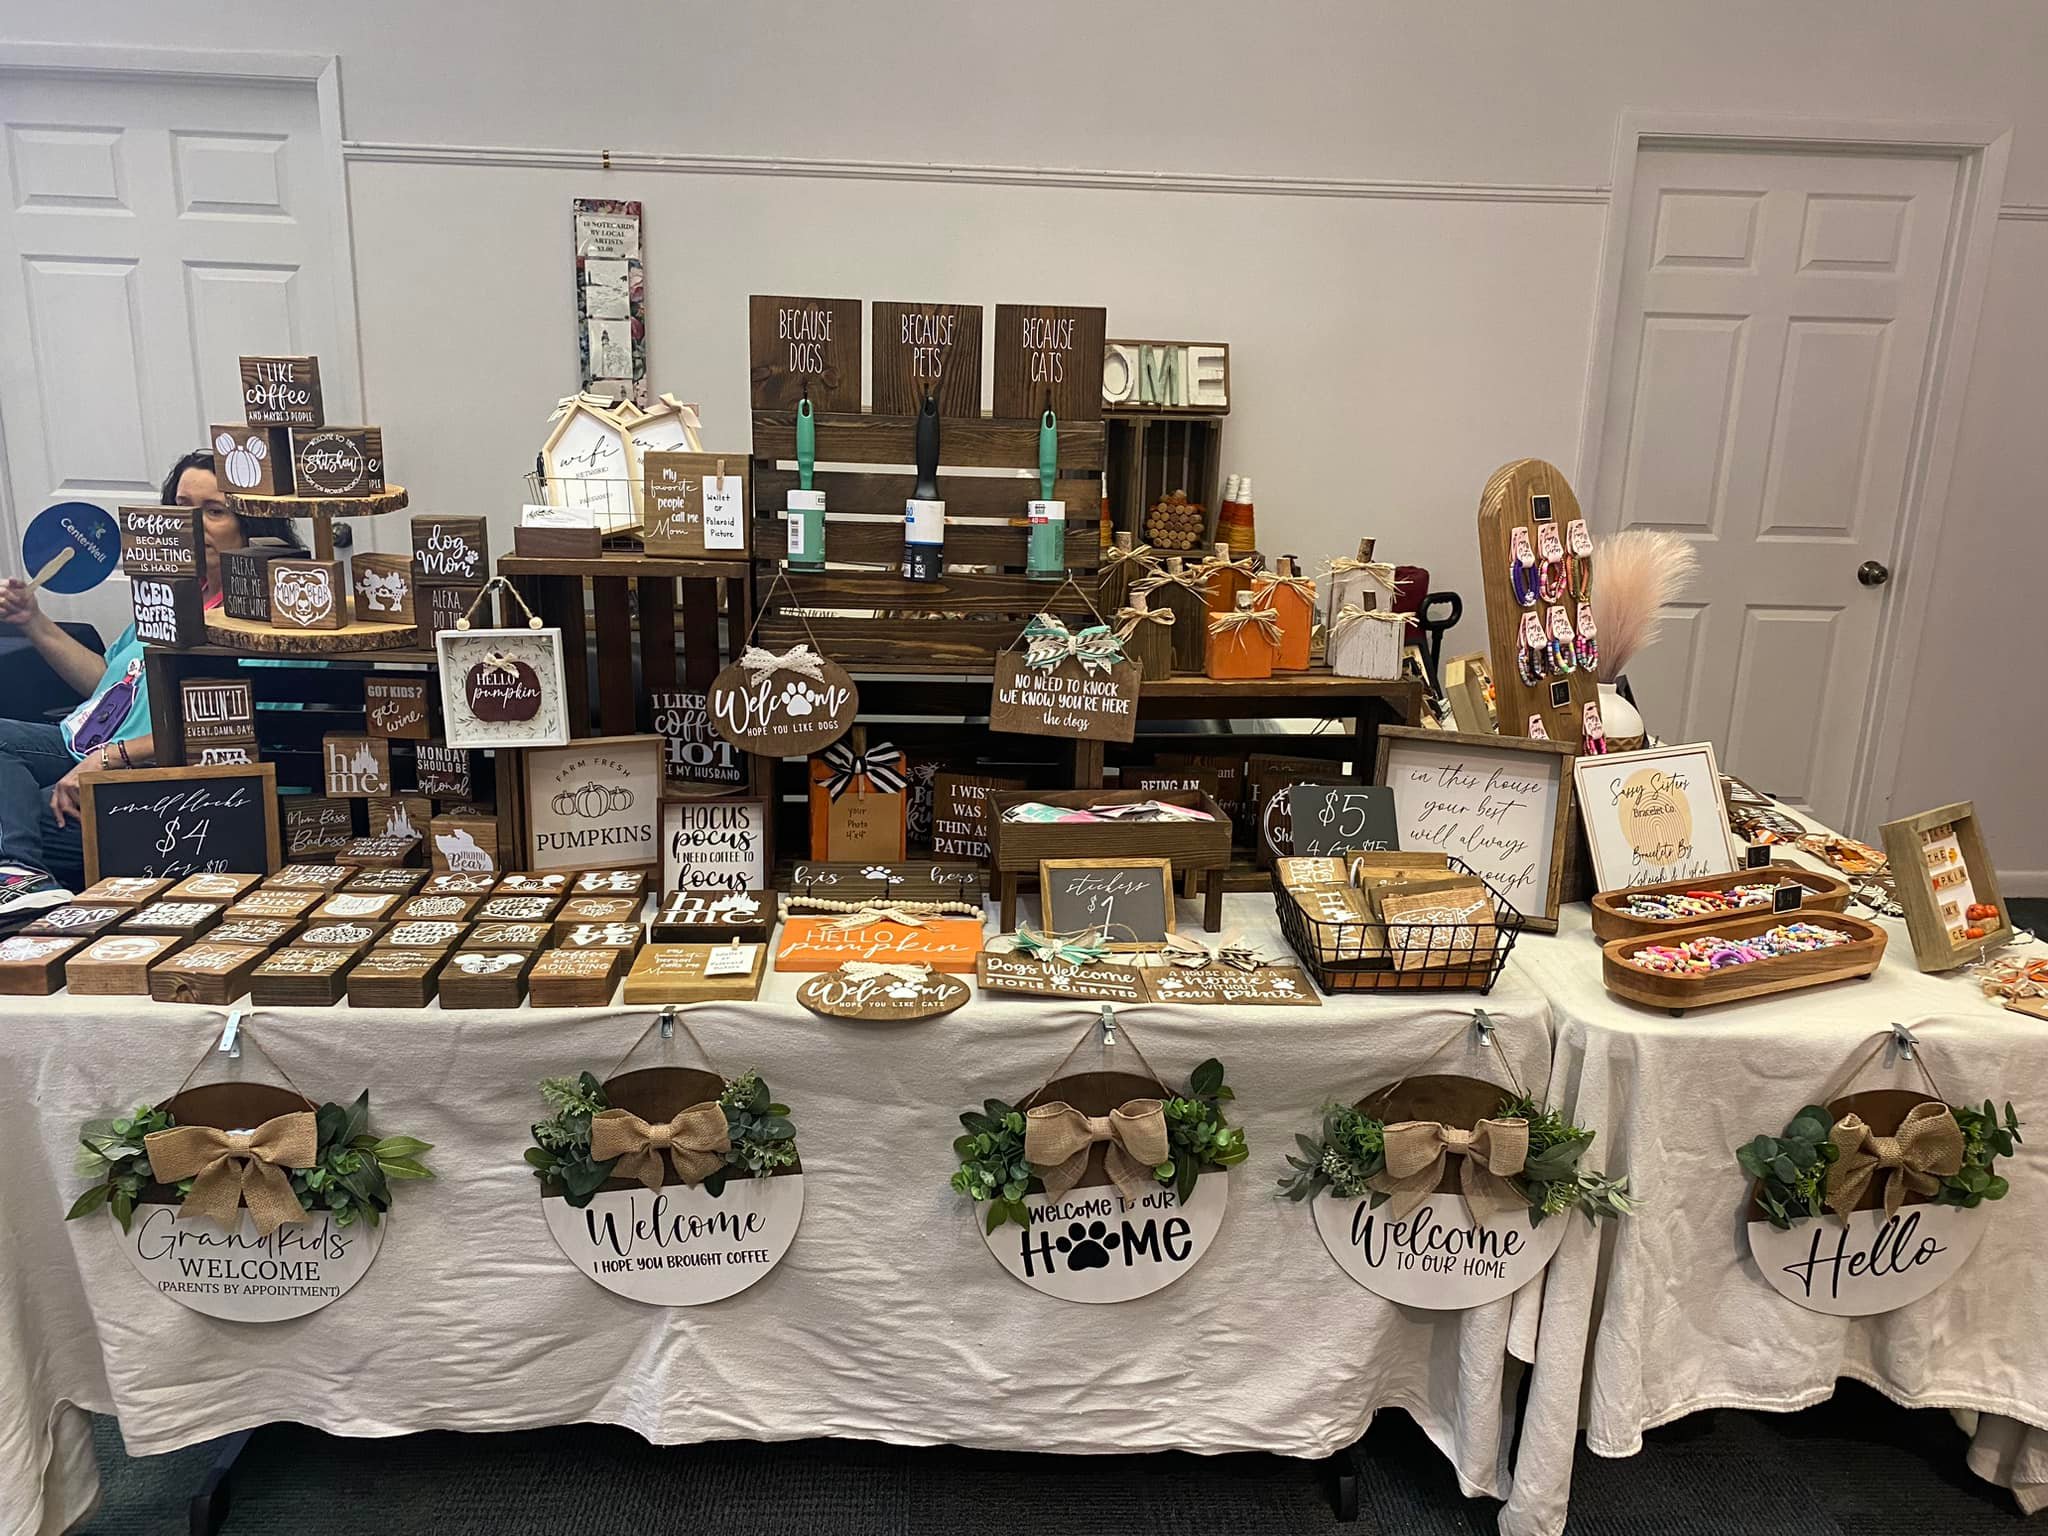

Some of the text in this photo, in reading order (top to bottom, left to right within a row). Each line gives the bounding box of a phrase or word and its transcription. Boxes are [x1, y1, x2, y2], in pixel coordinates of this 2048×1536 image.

[592, 221, 636, 231] NOTECARDS
[602, 230, 625, 238] LOCAL
[594, 237, 624, 246] ARTISTS
[778, 309, 833, 342] BECAUSE
[901, 314, 955, 347] BECAUSE
[1022, 317, 1076, 350] BECAUSE
[790, 343, 824, 375] DOGS
[913, 347, 943, 378] PETS
[1031, 351, 1064, 384] CATS
[257, 363, 294, 383] I LIKE
[246, 384, 311, 410] coffee
[248, 411, 263, 422] AND
[264, 411, 284, 422] MAYBE
[290, 412, 313, 423] PEOPLE
[560, 434, 620, 468] wifi
[663, 467, 678, 483] My
[650, 480, 699, 499] favorite
[706, 493, 731, 502] Wallet
[657, 496, 685, 511] people
[127, 512, 184, 535] Coffee
[647, 517, 689, 540] Mom
[671, 511, 701, 524] call me
[706, 516, 735, 528] Polaroid
[61, 518, 107, 563] CenterWell
[136, 536, 179, 547] BECAUSE
[428, 525, 468, 558] dog
[710, 528, 735, 539] Picture
[126, 548, 192, 563] ADULTING
[416, 550, 474, 579] Mom
[140, 563, 179, 574] IS HARD
[133, 579, 174, 608] ICED
[231, 576, 262, 598] POUR ME
[135, 605, 176, 626] COFFEE
[228, 595, 268, 619] SOME WINE
[433, 610, 445, 629] DO
[137, 621, 177, 643] ADDICT
[476, 671, 517, 687] HELLO
[1014, 673, 1119, 697] NO NEED TO KNOCK
[367, 685, 424, 699] GOT KIDS?
[471, 681, 541, 710] pumpkin
[661, 693, 707, 710] LIKE
[999, 689, 1131, 715] WE KNOW YOU'RE HERE
[371, 700, 400, 727] get
[1063, 712, 1090, 732] dogs
[747, 720, 839, 737] HOPE YOU LIKE DOGS
[416, 745, 467, 763] MONDAY
[417, 759, 468, 775] SHOULD BE
[556, 757, 632, 784] FARM FRESH
[676, 765, 692, 777] MY
[694, 767, 741, 782] HUSBAND
[418, 774, 470, 797] optional
[1411, 763, 1543, 794] in this house
[1609, 771, 1691, 808] Sassy Sisters
[951, 785, 956, 797] I
[109, 787, 252, 818] small blocks
[953, 804, 981, 818] WAS
[1319, 789, 1368, 838] $5
[1418, 795, 1527, 825] your best
[1633, 803, 1678, 819] Bracelet Co.
[681, 805, 750, 831] HOCUS
[936, 820, 971, 835] THIN
[155, 816, 211, 859] $4
[290, 827, 352, 853] Badass
[536, 823, 652, 852] PUMPKINS
[672, 828, 758, 860] pocus
[1306, 839, 1320, 856] 4
[1410, 823, 1529, 861] will always
[682, 850, 755, 864] NEED COFFEE TO
[1677, 838, 1694, 860] By
[1927, 849, 1947, 864] THE
[142, 865, 154, 880] 3
[162, 860, 200, 880] for
[677, 862, 754, 892] focus
[794, 866, 844, 886] his
[1066, 871, 1151, 895] stickers
[147, 902, 218, 913] ICED
[779, 931, 970, 959] pumpkin
[806, 930, 894, 944] HELLO
[551, 949, 610, 960] coffee
[536, 962, 611, 972] ADULTING
[987, 958, 1137, 984] Dogs Welcome
[1180, 970, 1221, 978] HOUSE
[986, 977, 1139, 999] PEOPLE TOLERATED
[1184, 976, 1266, 986] home
[1200, 983, 1258, 991] WITHOUT
[839, 1000, 946, 1008] HOPE YOU LIKE CATS
[1156, 989, 1308, 1001] paw prints
[137, 1208, 353, 1261] Grandkids
[586, 1194, 767, 1257] Welcome
[1351, 1200, 1527, 1268] Welcome
[593, 1249, 771, 1274] I HOPE YOU BROUGHT COFFEE
[1396, 1251, 1508, 1279] TO OUR HOME
[1782, 1211, 1949, 1299] Hello
[177, 1257, 321, 1282] WELCOME
[158, 1281, 341, 1298] (PARENTS BY APPOINTMENT)
